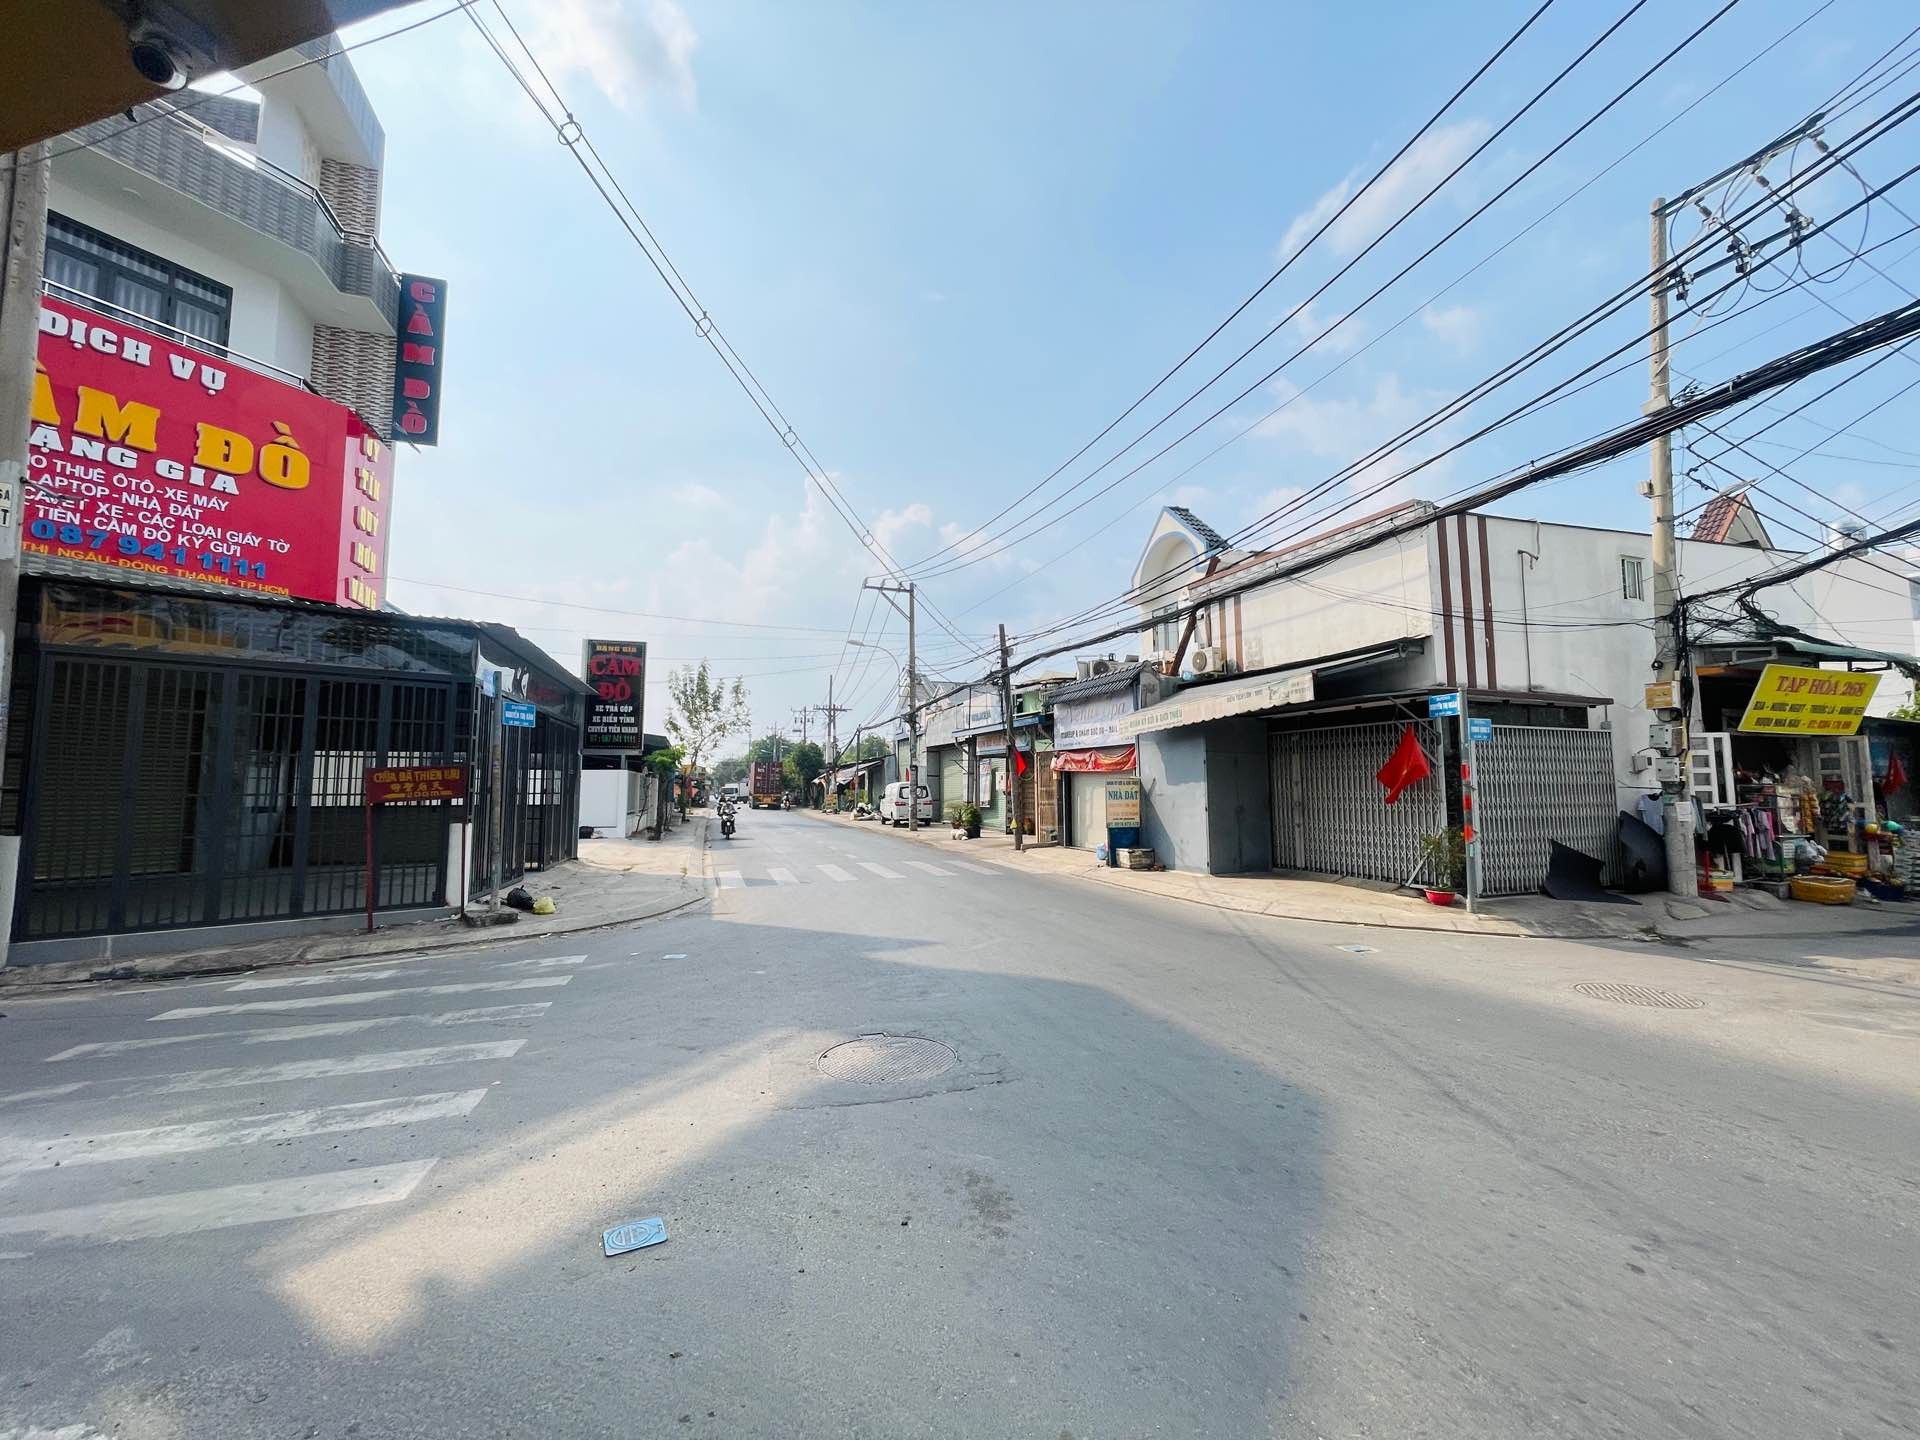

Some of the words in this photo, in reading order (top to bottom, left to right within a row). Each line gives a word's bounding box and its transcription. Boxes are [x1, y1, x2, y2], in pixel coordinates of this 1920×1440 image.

[39, 308, 151, 366] DỊCH
[169, 354, 226, 395] VỤ
[155, 459, 239, 495] GIA
[194, 421, 310, 489] ĐỒ
[53, 459, 106, 483] THUÊ
[194, 496, 229, 511] MÁY
[96, 501, 124, 518] XE
[138, 511, 176, 529] CÁC
[31, 519, 108, 549] 087
[118, 540, 187, 565] 941
